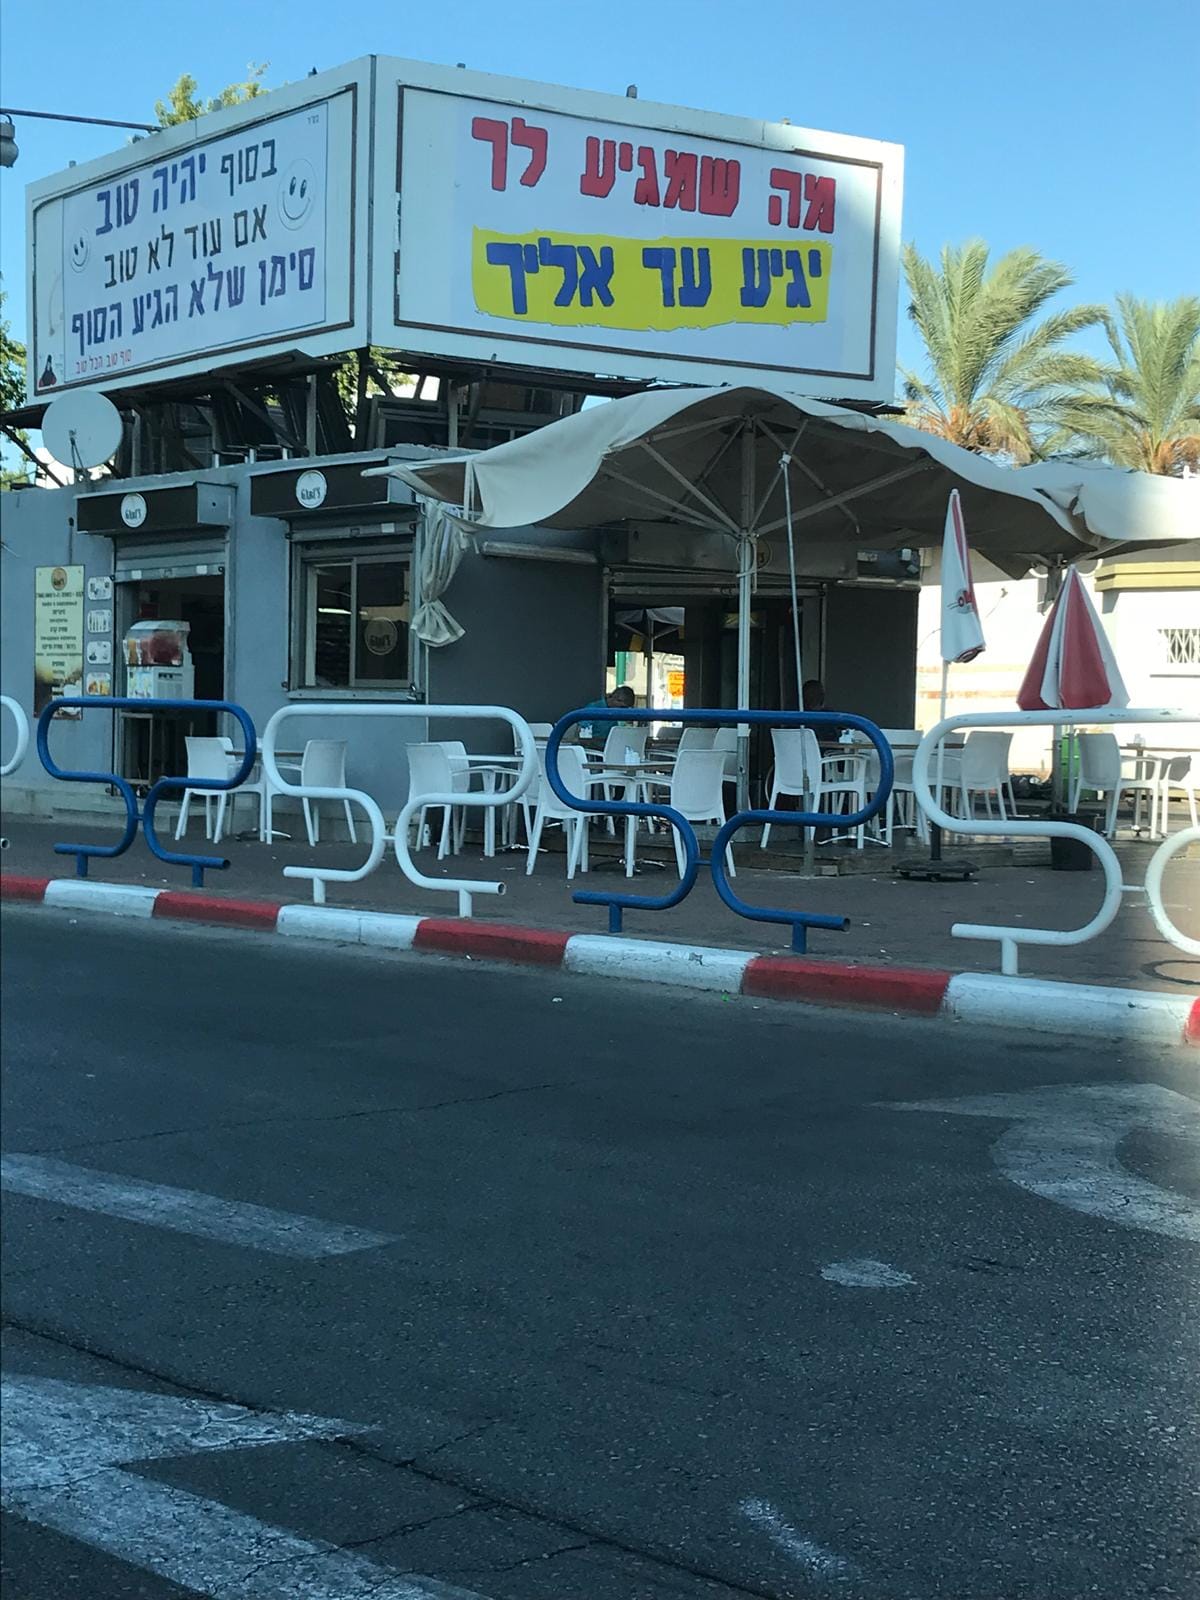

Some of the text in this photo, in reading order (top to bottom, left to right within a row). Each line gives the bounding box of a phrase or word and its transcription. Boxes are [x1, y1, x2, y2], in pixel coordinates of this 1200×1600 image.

[95, 138, 278, 236] בסוף יהיה טוב
[471, 116, 837, 234] מה שמגיע לך
[104, 204, 269, 289] אם עוד לא טוב
[486, 237, 822, 315] יגיע עד אליך
[71, 247, 316, 357] סימן שלא הגיע הסוף
